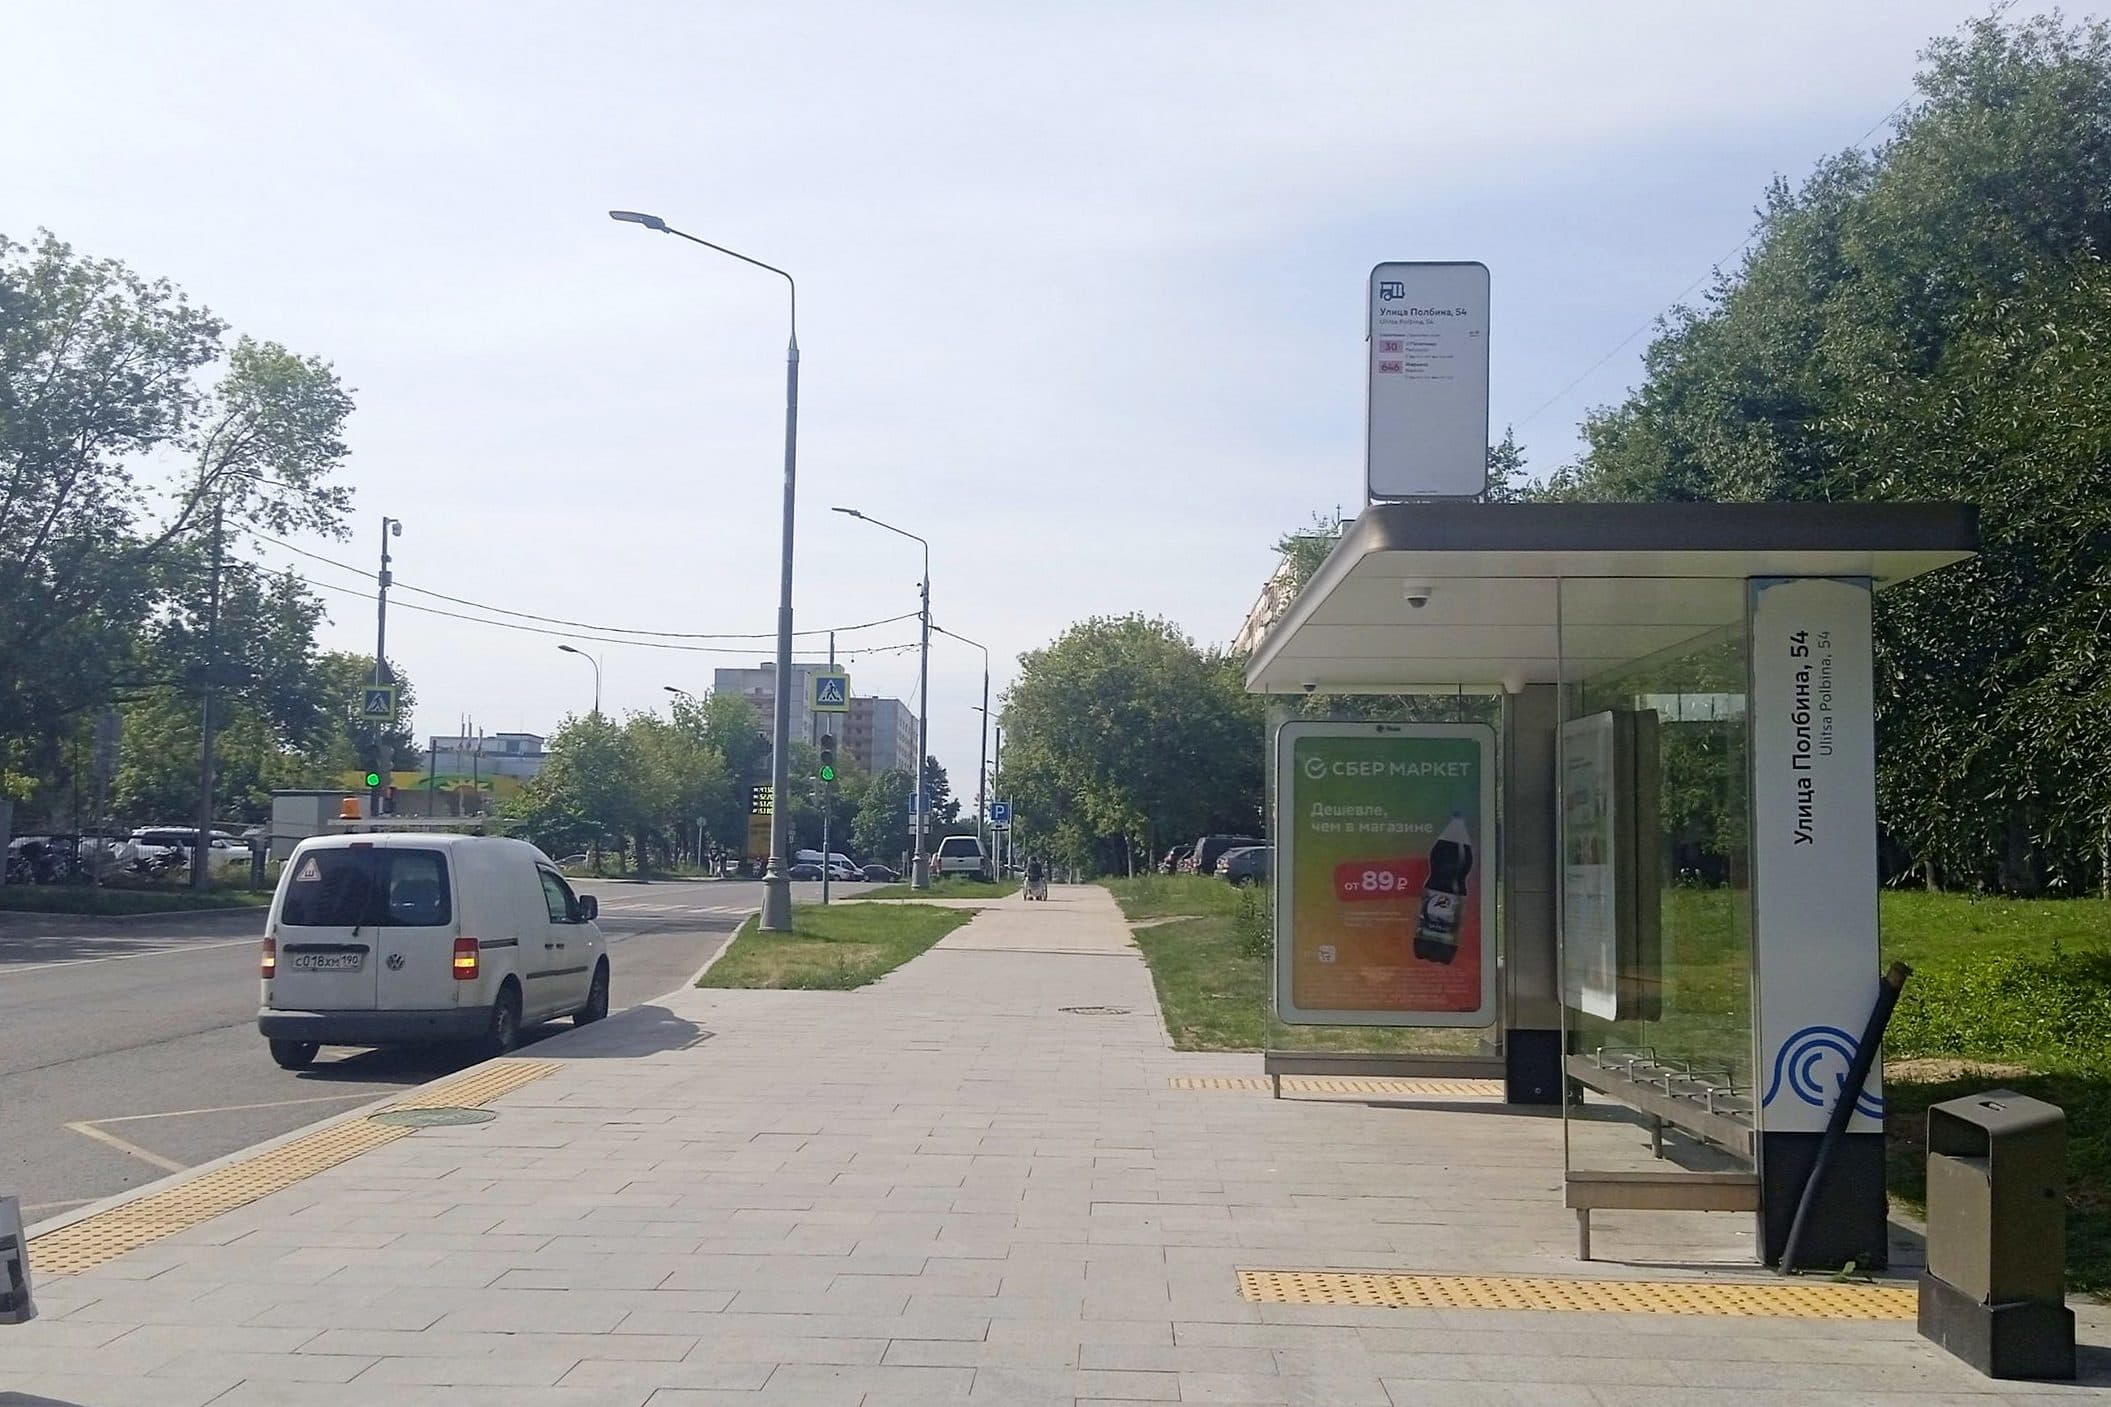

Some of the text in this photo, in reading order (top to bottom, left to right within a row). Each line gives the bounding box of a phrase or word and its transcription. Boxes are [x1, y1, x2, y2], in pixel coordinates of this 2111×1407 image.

[1379, 308, 1467, 317] Улица Полбина, 54
[1385, 342, 1398, 351] 30
[1818, 631, 1832, 756] Ulitsa Polbina, 54
[1790, 630, 1815, 844] Улица Полбина, 54
[1332, 761, 1471, 776] СБЕР МАРКЕТ
[1311, 802, 1388, 818] Дешевле,
[1311, 822, 1433, 833] чем в магазине
[1344, 880, 1360, 891] от
[1361, 871, 1394, 890] 89
